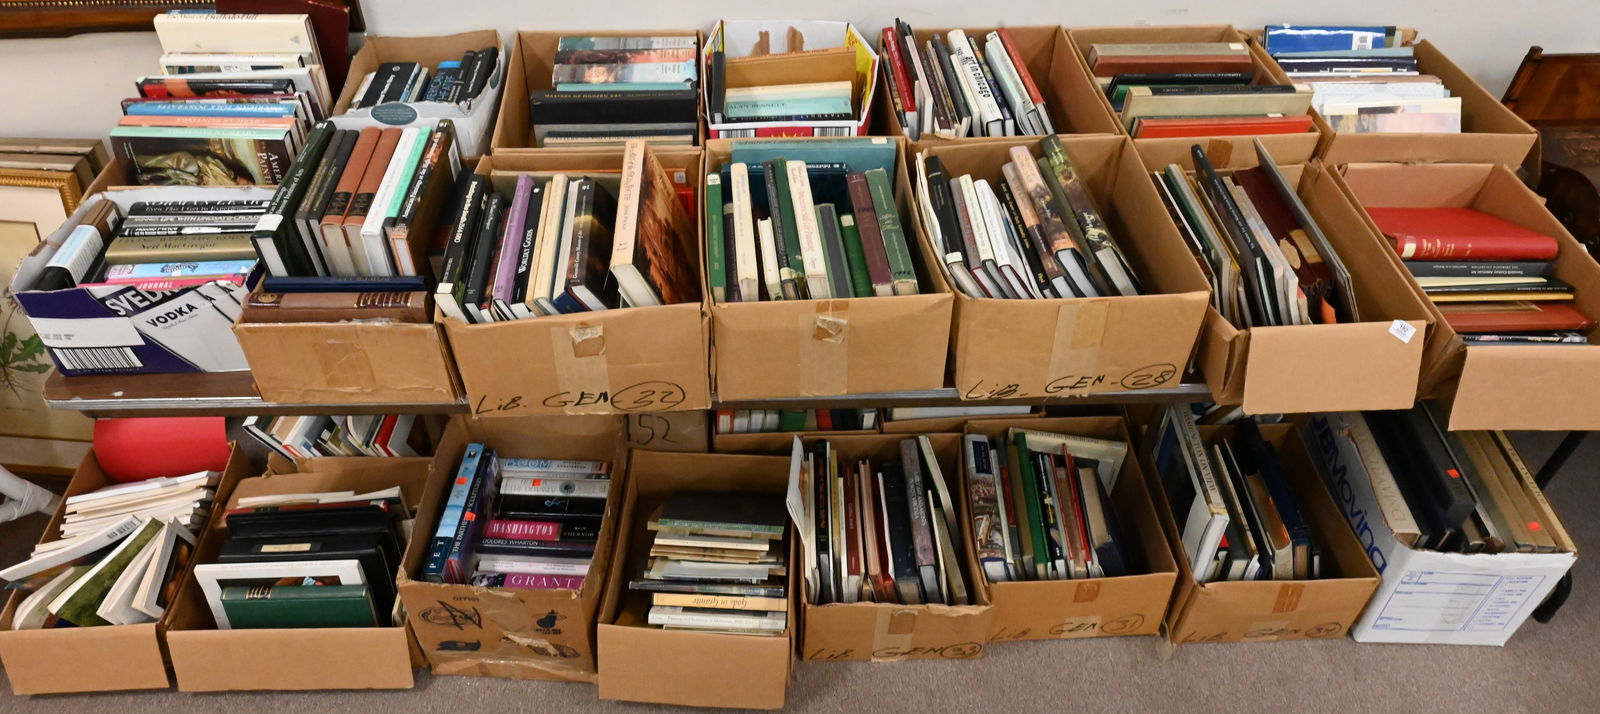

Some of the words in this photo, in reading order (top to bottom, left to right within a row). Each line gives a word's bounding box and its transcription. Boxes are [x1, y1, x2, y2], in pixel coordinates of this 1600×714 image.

[973, 72, 991, 98] chicago
[522, 226, 534, 248] GOODS
[517, 247, 531, 274] WORLDLY
[136, 281, 173, 290] JOURNAL
[145, 302, 199, 328] VODKA
[1043, 372, 1107, 395] GEN
[541, 390, 609, 408] GEN
[620, 412, 681, 449] 152
[1197, 457, 1209, 472] ON
[1202, 471, 1217, 492] VIEW
[454, 506, 473, 543] PARTHEN
[491, 523, 554, 536] WASHINGTON
[451, 541, 461, 554] THE
[511, 574, 575, 589] GRANT
[691, 596, 718, 607] Granite
[730, 597, 747, 609] Gods
[1047, 620, 1098, 636] GEN
[1242, 625, 1302, 639] GEN
[871, 644, 941, 658] GEN
